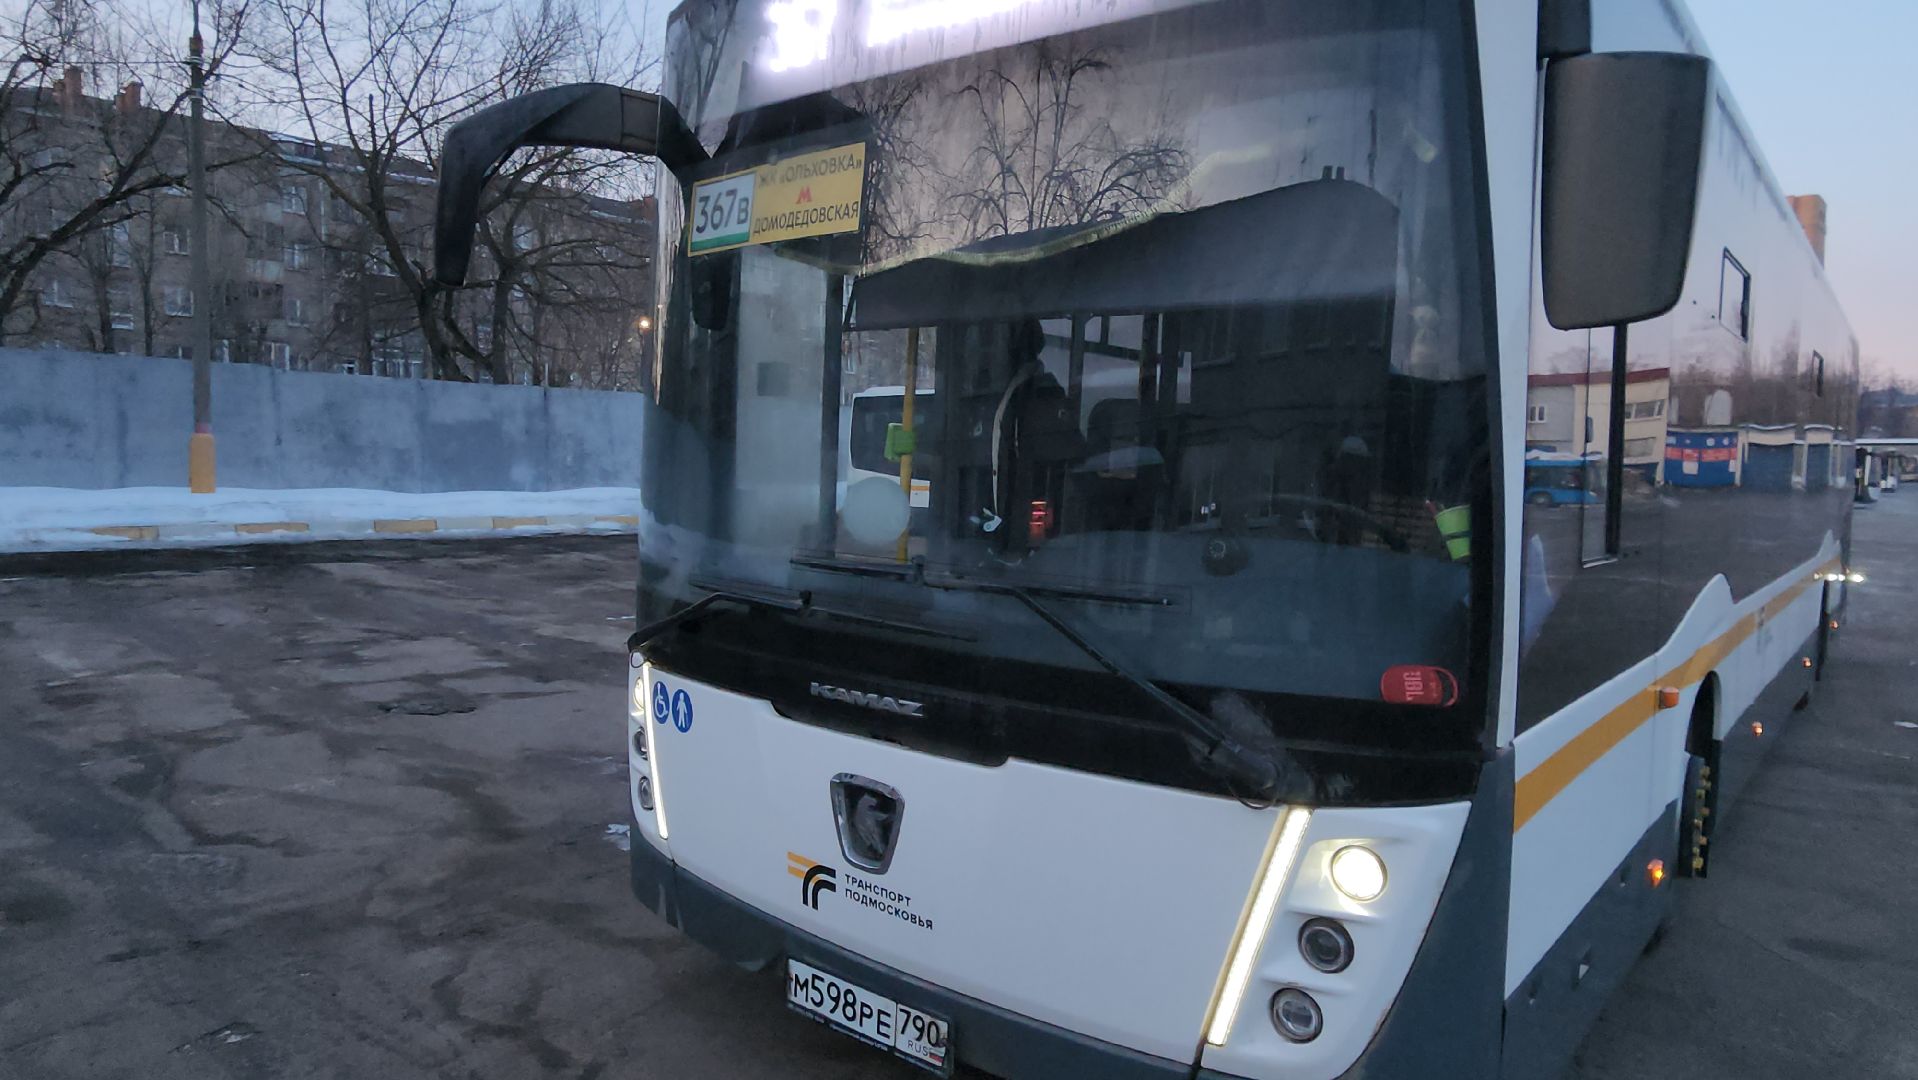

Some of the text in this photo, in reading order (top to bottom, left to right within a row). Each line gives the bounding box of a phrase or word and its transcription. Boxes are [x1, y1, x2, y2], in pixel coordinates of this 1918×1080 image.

[780, 153, 863, 184] «ОЛЬХОВКА»
[753, 200, 859, 235] ДОМОДЕДОВСКАЯ
[810, 682, 924, 717] KAMAZ
[1403, 671, 1424, 702] JBL
[844, 873, 911, 907] ТРАНСПОРТ
[845, 888, 933, 930] ПОДМОСКОВЬЯ
[899, 1008, 941, 1048] 790
[907, 1039, 929, 1056] RUS
